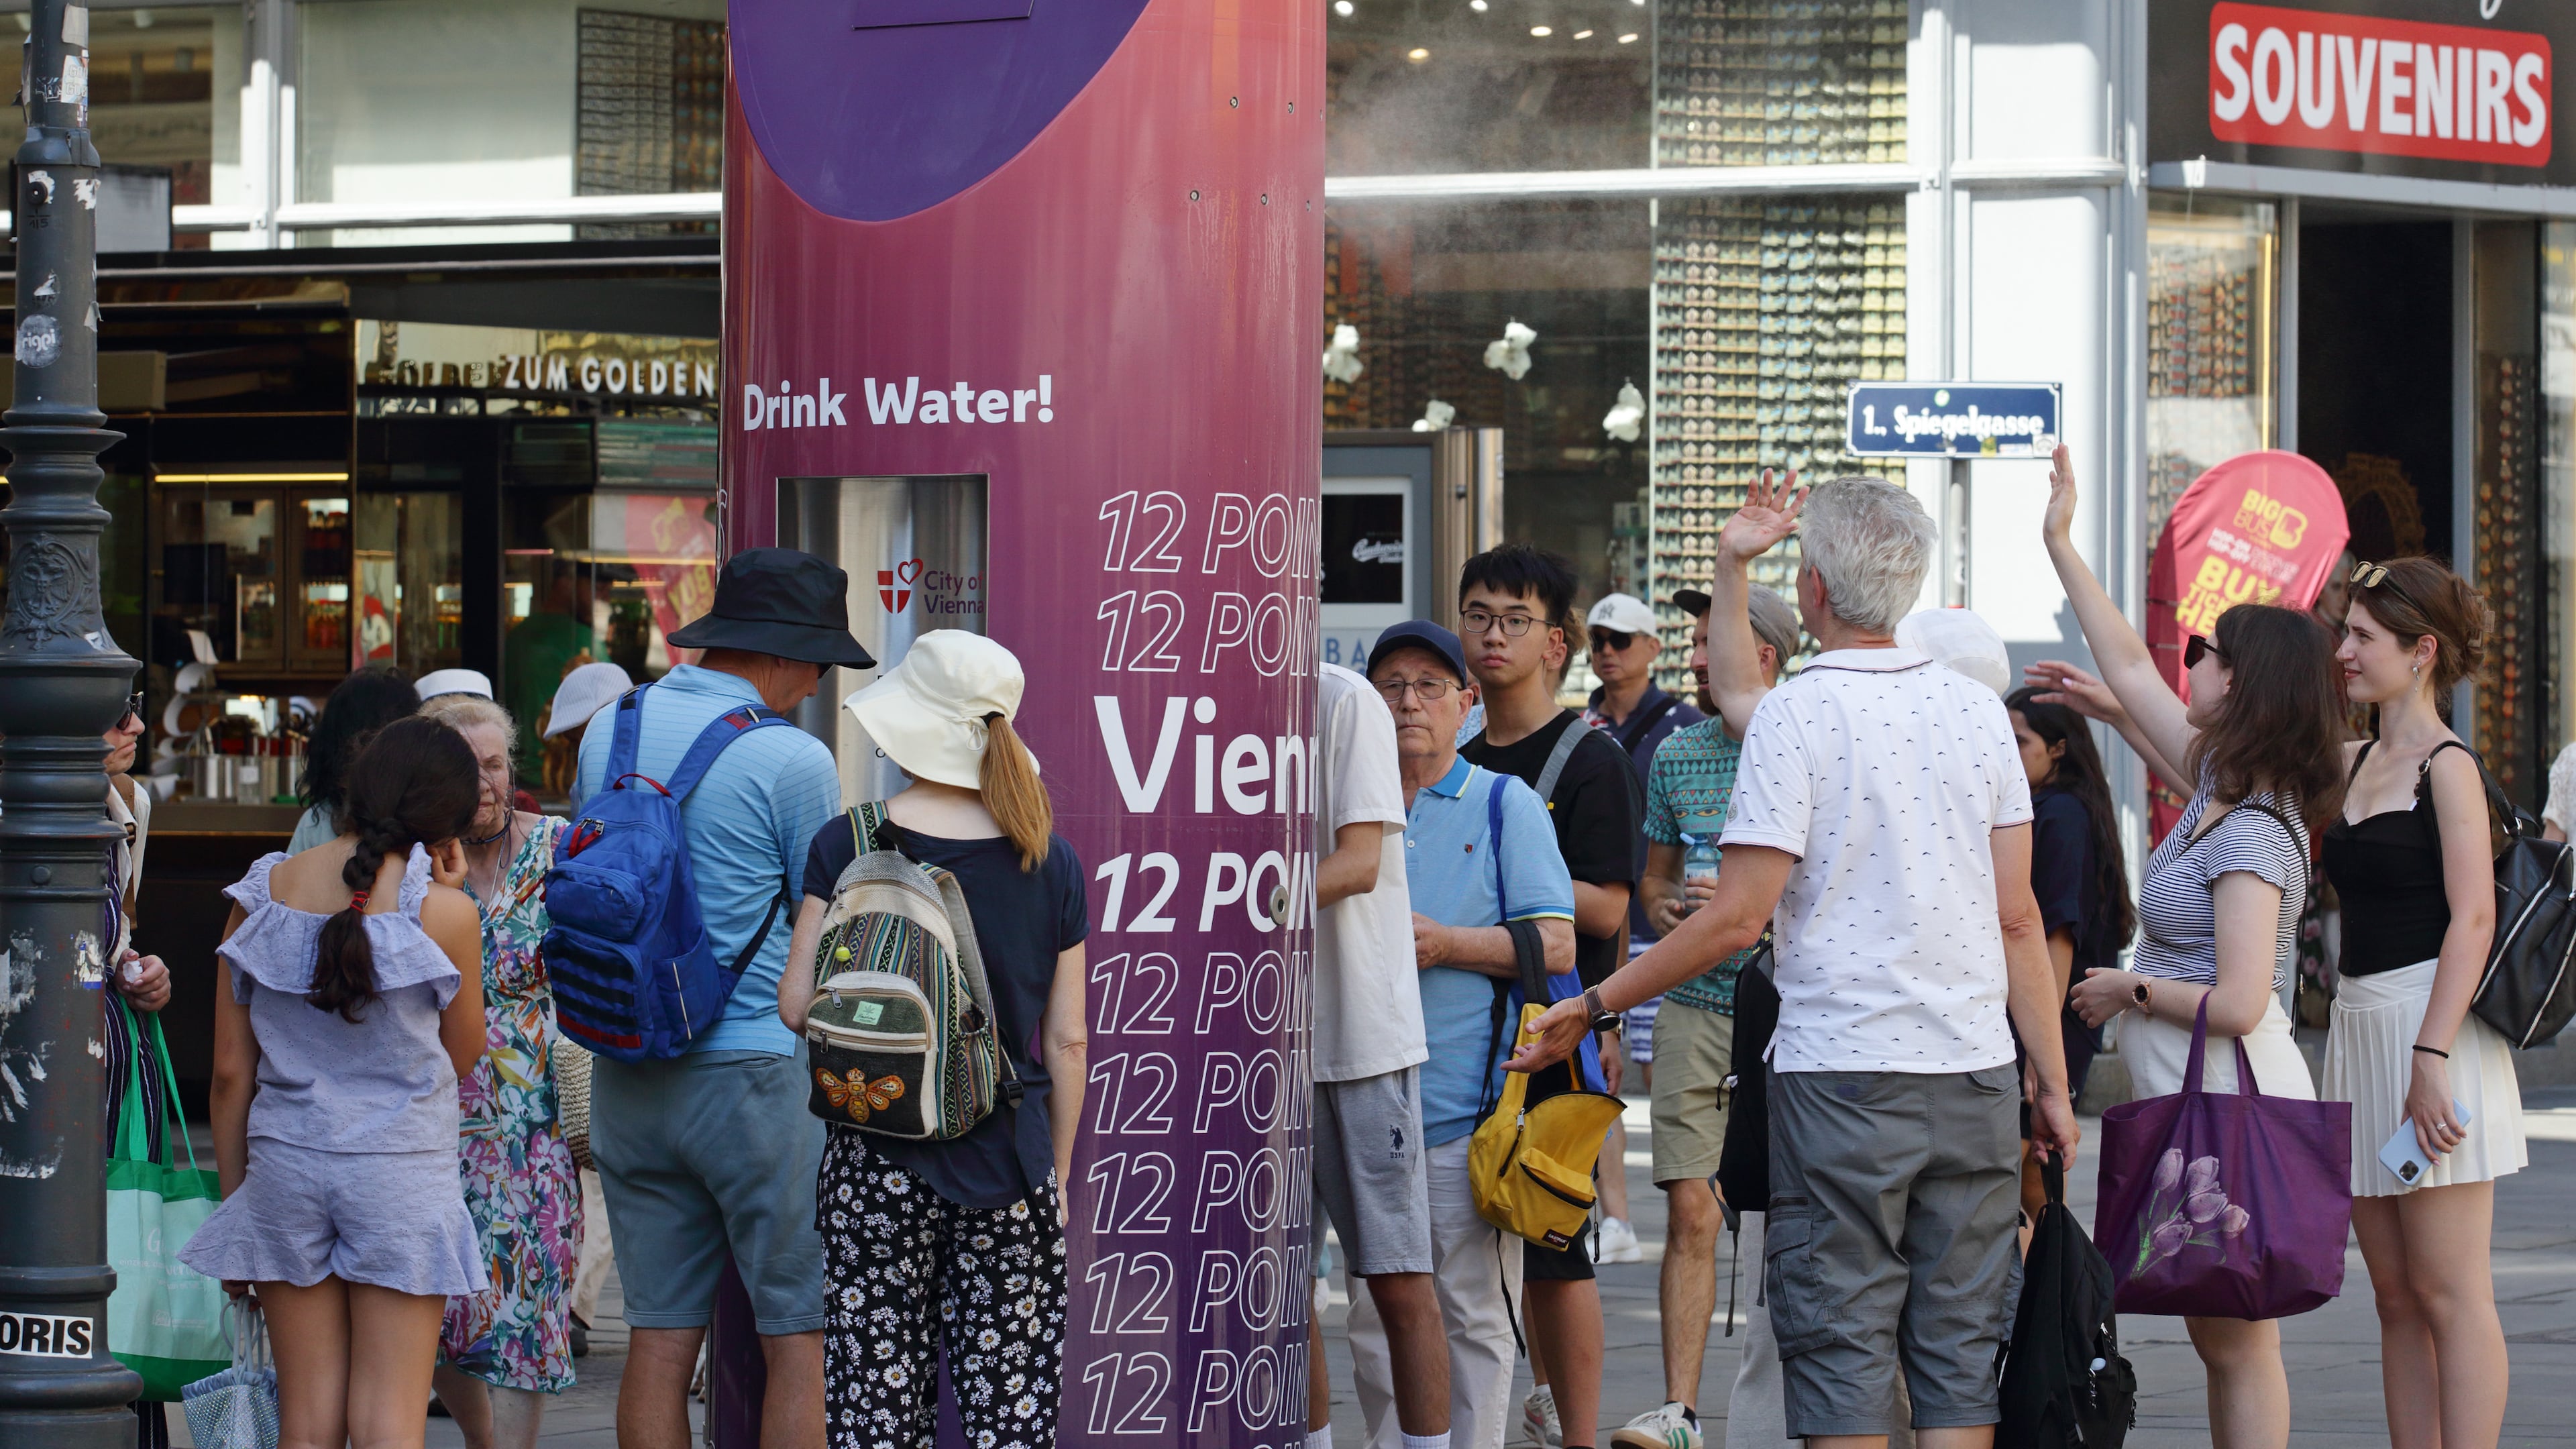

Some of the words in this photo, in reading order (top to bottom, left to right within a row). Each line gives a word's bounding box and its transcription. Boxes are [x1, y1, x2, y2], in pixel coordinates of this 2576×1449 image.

[2215, 23, 2546, 147] SOUVENIRS
[504, 354, 568, 391] ZUM
[580, 359, 715, 397] GOLDEN
[744, 378, 847, 431] Drink
[863, 374, 1055, 425] Water!
[1894, 405, 2045, 443] Spiegelgasse
[1098, 490, 1187, 573] 12
[2233, 508, 2273, 538] BUS
[2241, 488, 2282, 521] BIG
[924, 571, 963, 596] City
[968, 571, 984, 590] of
[924, 594, 985, 614] Vienna
[2195, 555, 2281, 604] BUY
[1097, 590, 1185, 673] 12
[1095, 851, 1180, 932] 12
[1091, 952, 1179, 1034] 12
[1089, 1052, 1177, 1134] 12
[1087, 1151, 1175, 1234] 12
[1085, 1251, 1173, 1334] 12
[0, 1315, 91, 1355] ORIS
[1082, 1351, 1171, 1434] 12
